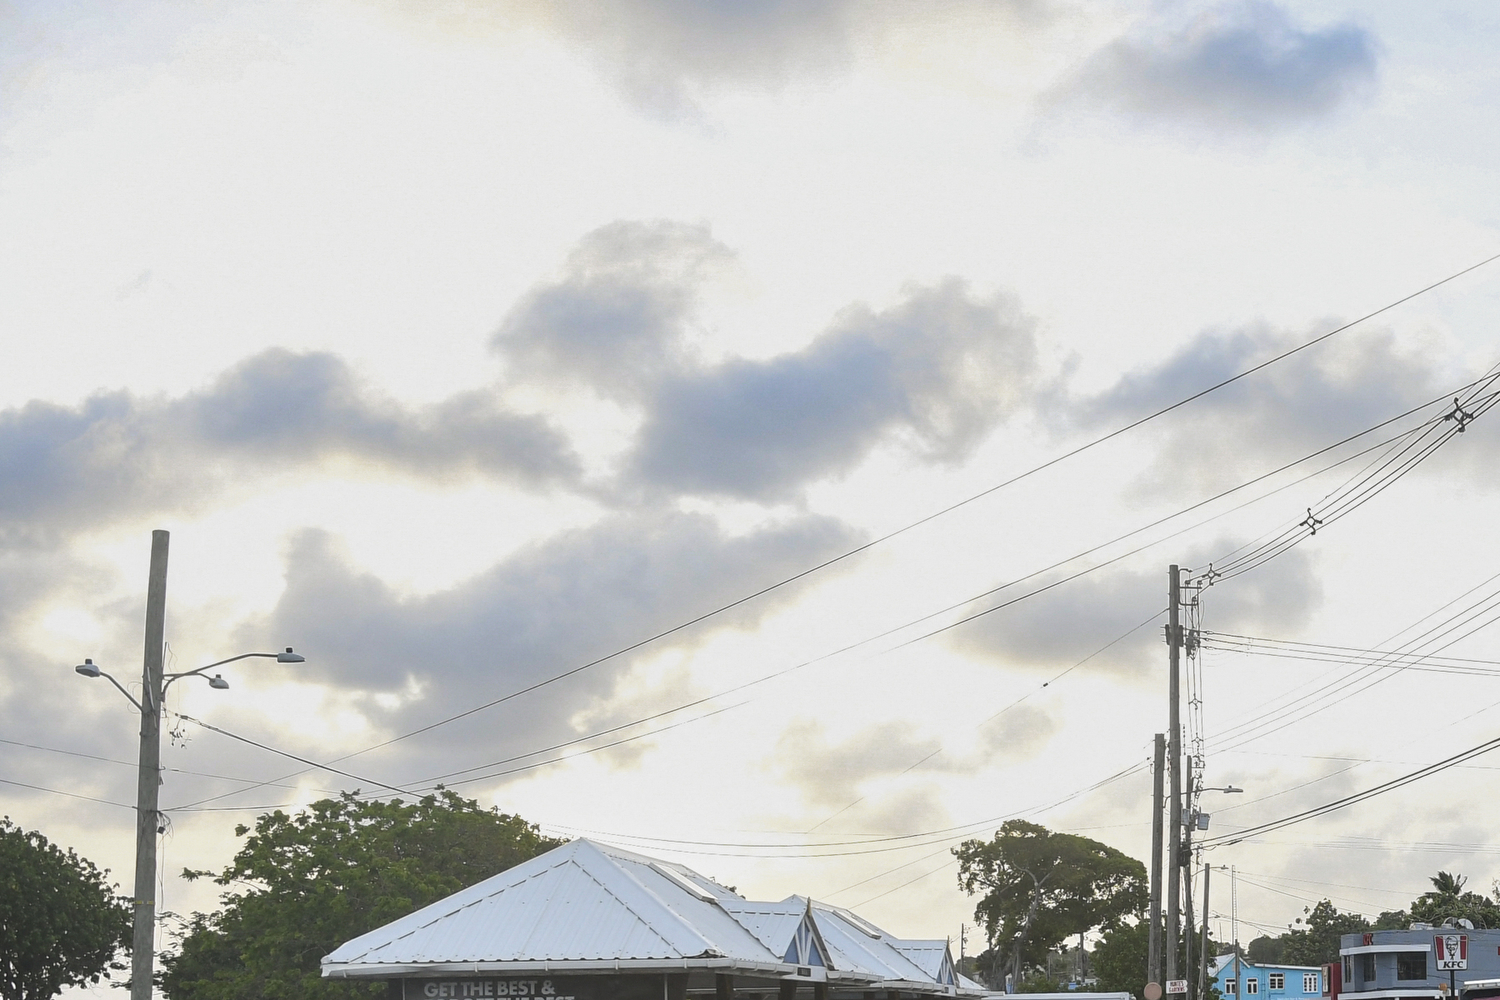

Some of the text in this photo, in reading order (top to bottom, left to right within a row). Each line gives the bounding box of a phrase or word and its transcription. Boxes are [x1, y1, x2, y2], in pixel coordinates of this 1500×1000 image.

[424, 980, 556, 997] GET THE BEST &
